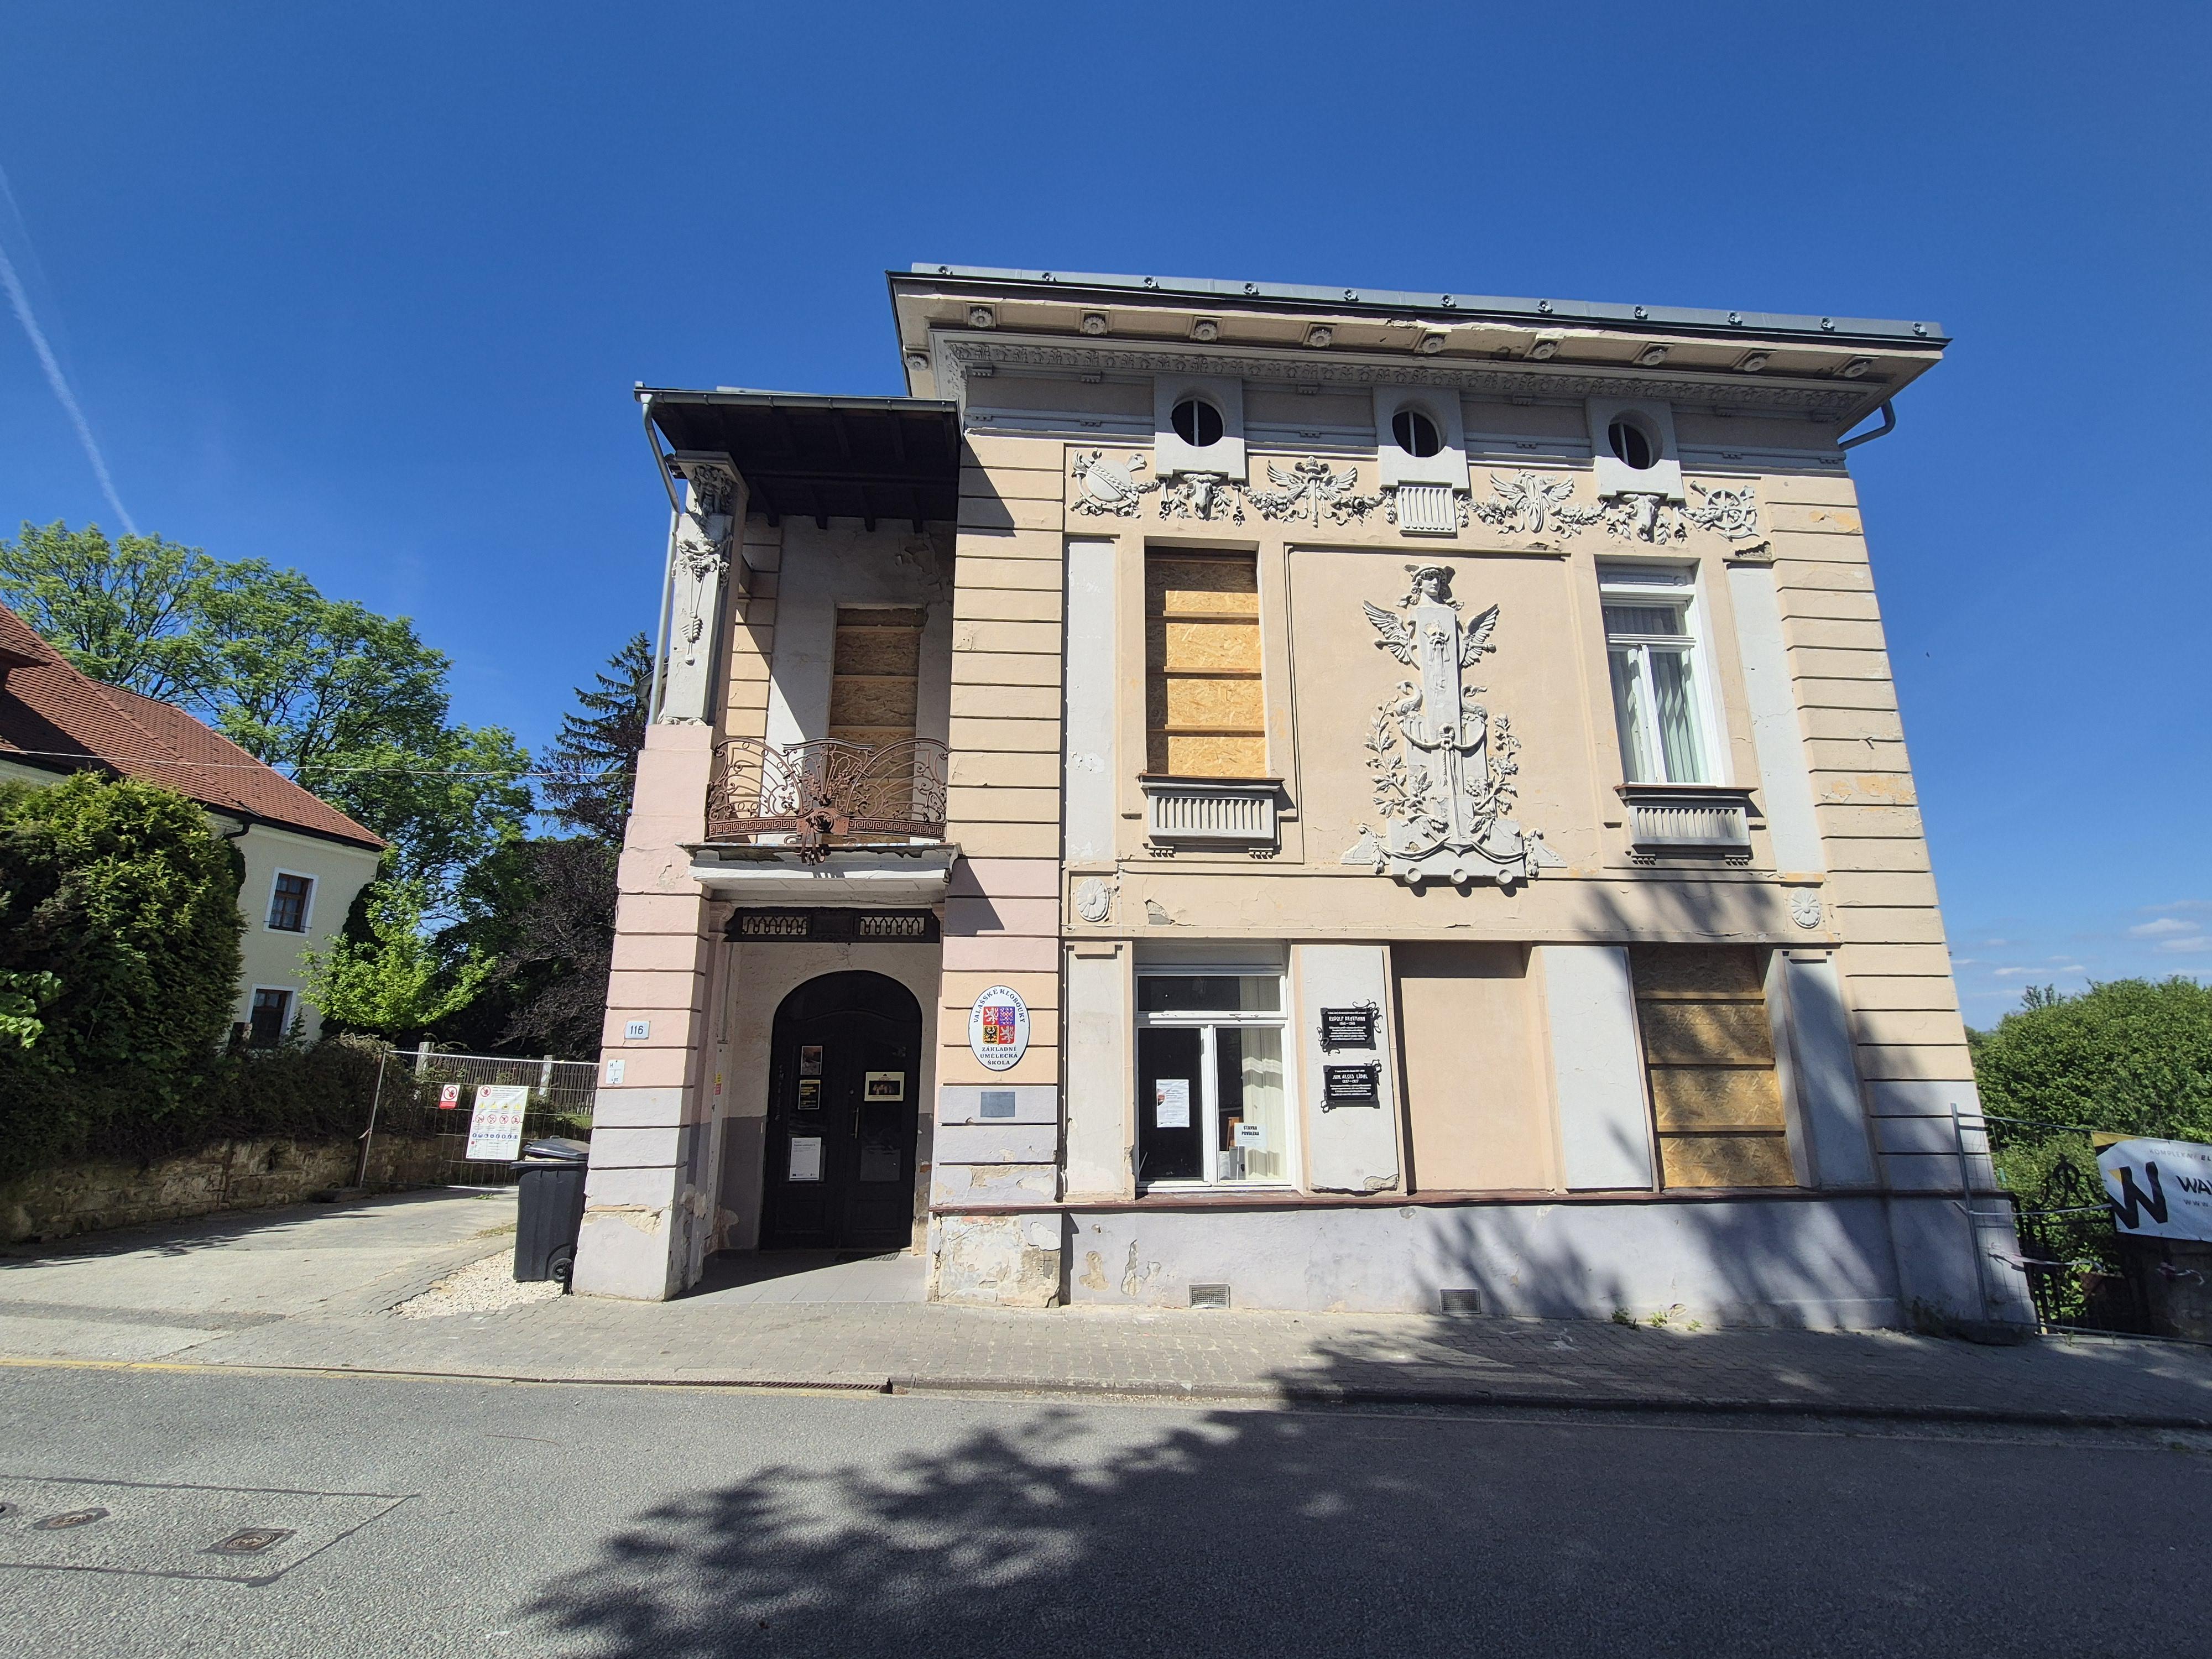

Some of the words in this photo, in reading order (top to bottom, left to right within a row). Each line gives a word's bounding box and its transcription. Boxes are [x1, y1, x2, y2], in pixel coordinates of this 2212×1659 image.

[974, 988, 998, 1022] VALAŠSKÉ
[1000, 989, 1025, 1022] KLOBOUKY
[630, 1025, 643, 1035] 116
[2176, 1175, 2212, 1195] WA
